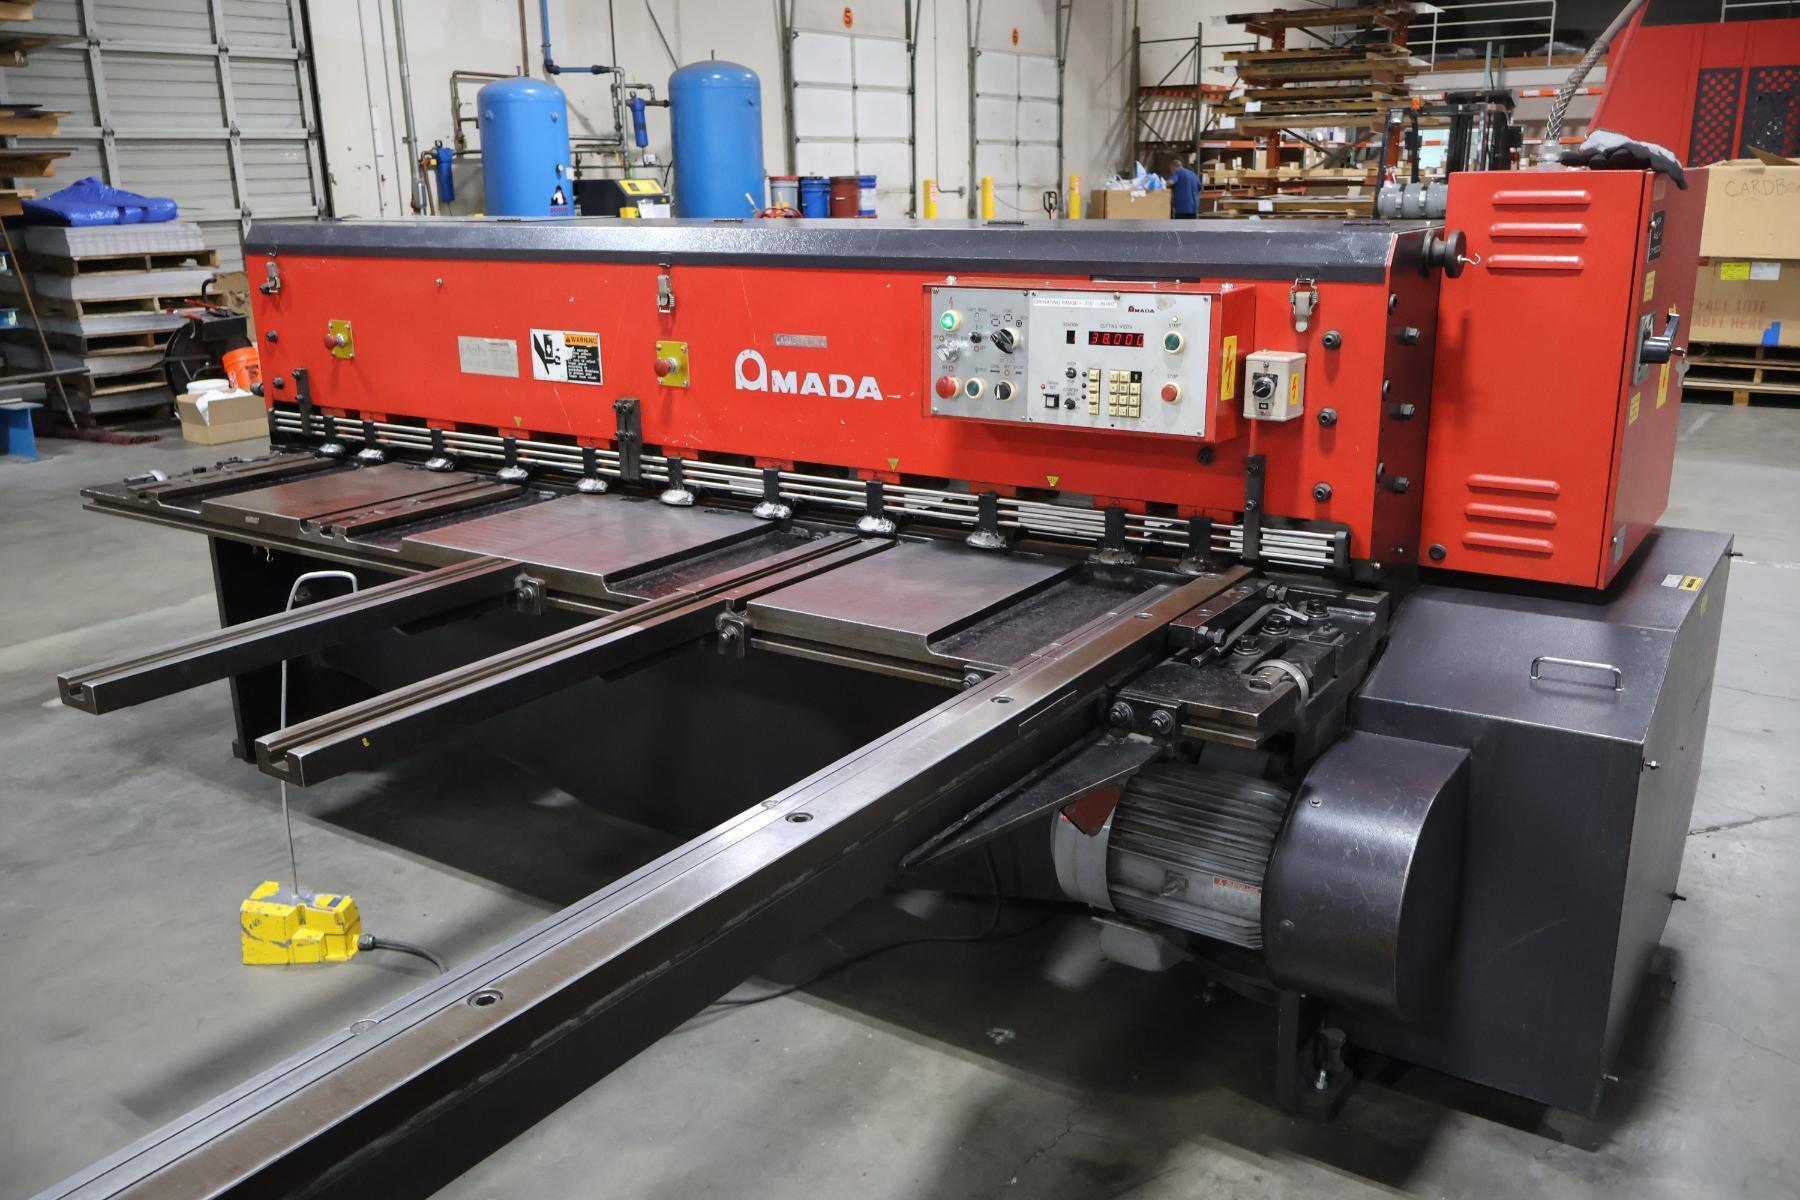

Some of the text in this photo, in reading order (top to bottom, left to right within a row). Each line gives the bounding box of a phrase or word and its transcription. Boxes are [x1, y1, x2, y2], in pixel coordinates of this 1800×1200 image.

[1724, 177, 1800, 197] CARDBO
[1127, 305, 1155, 314] AMADA
[570, 335, 598, 345] WARNING
[735, 348, 883, 400] AMADA
